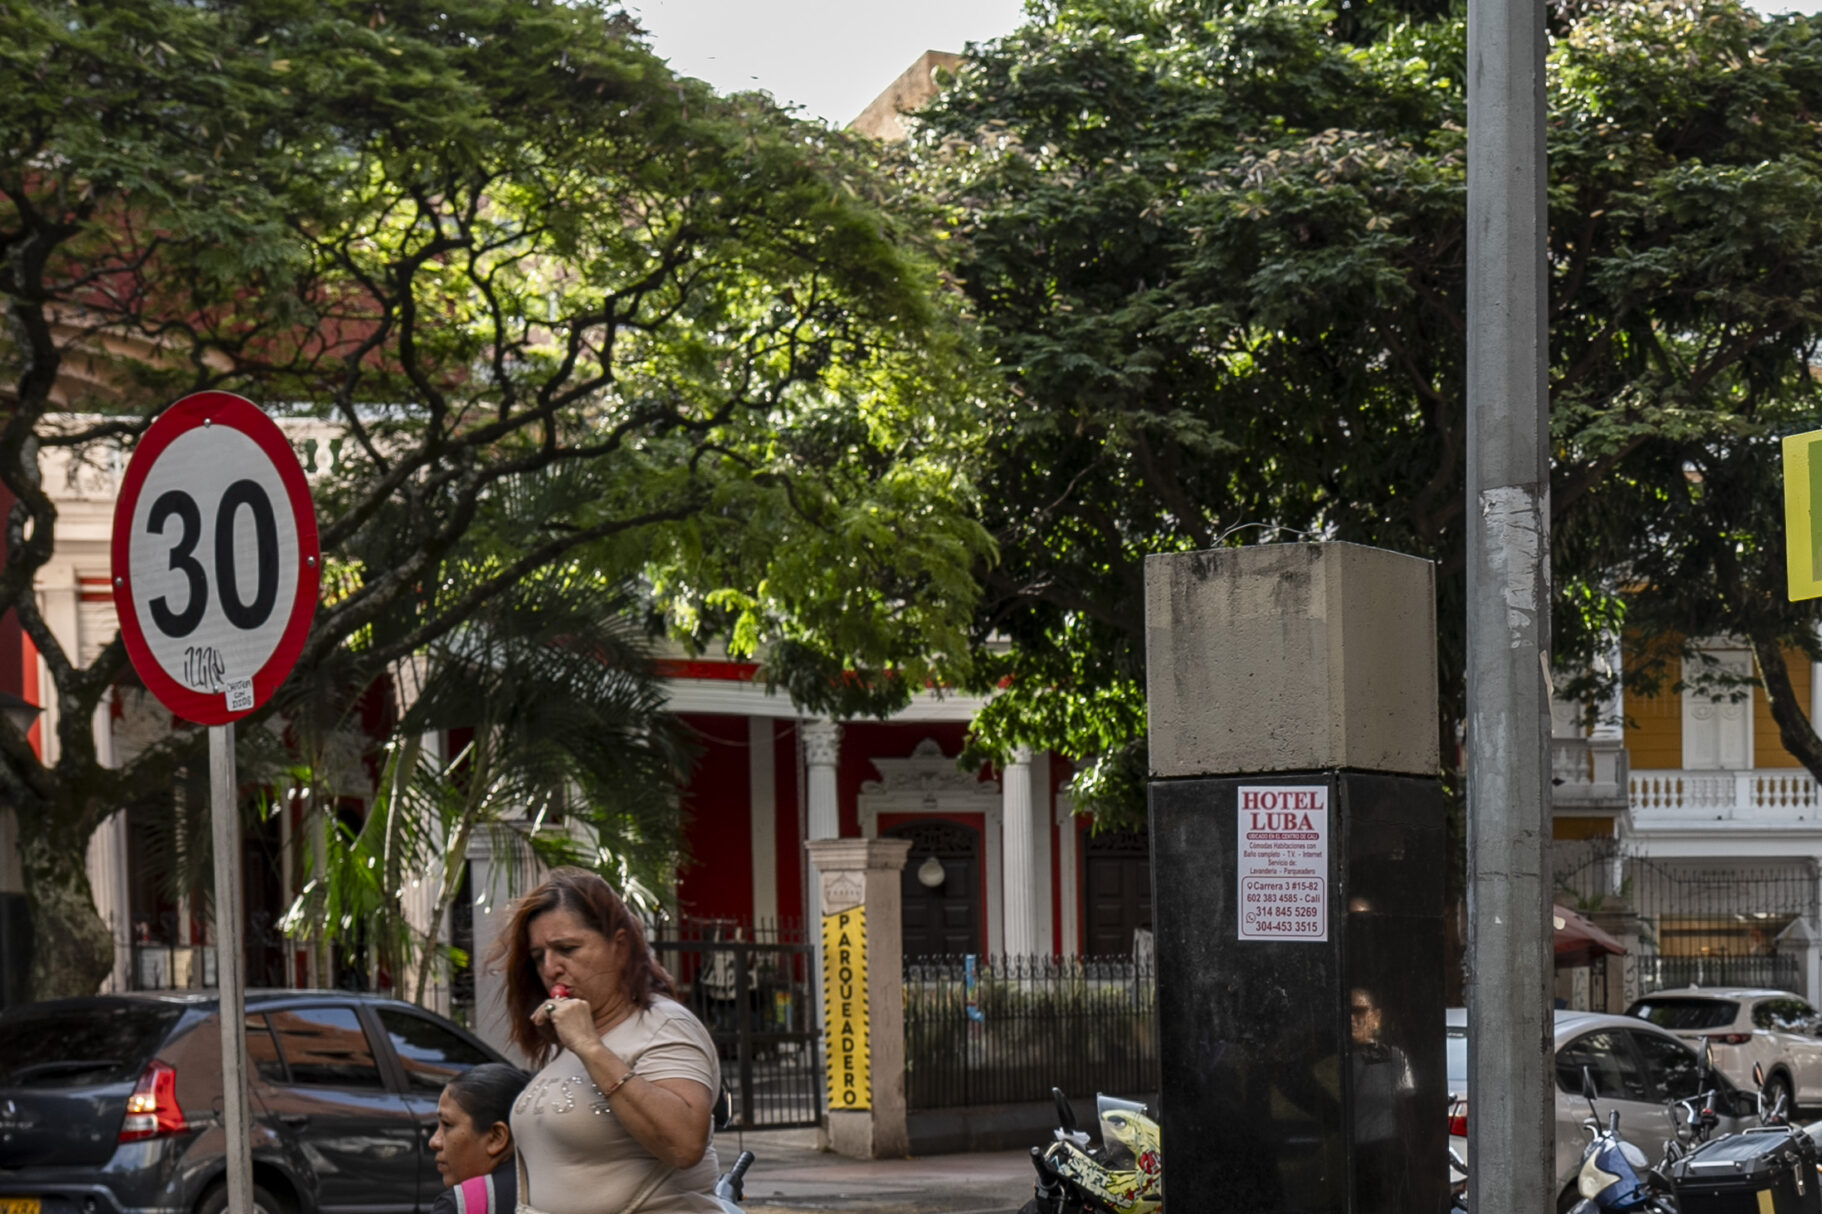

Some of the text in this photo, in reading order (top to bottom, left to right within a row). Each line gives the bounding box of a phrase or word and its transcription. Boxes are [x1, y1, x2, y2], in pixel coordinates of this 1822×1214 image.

[146, 478, 280, 639] 30
[1242, 791, 1324, 810] HOTEL
[1250, 812, 1315, 831] LUBA
[1274, 841, 1305, 849] Habitaciones
[1258, 850, 1280, 858] completo
[1284, 868, 1316, 876] Parqueadero
[1254, 881, 1318, 891] Carrera 3 #15-82
[1247, 894, 1320, 903] 602 383 4585 Cali
[1256, 906, 1317, 917] 314 845 5269
[1256, 921, 1318, 932] 304-453 3515
[837, 914, 857, 1106] PARQUEADERO
